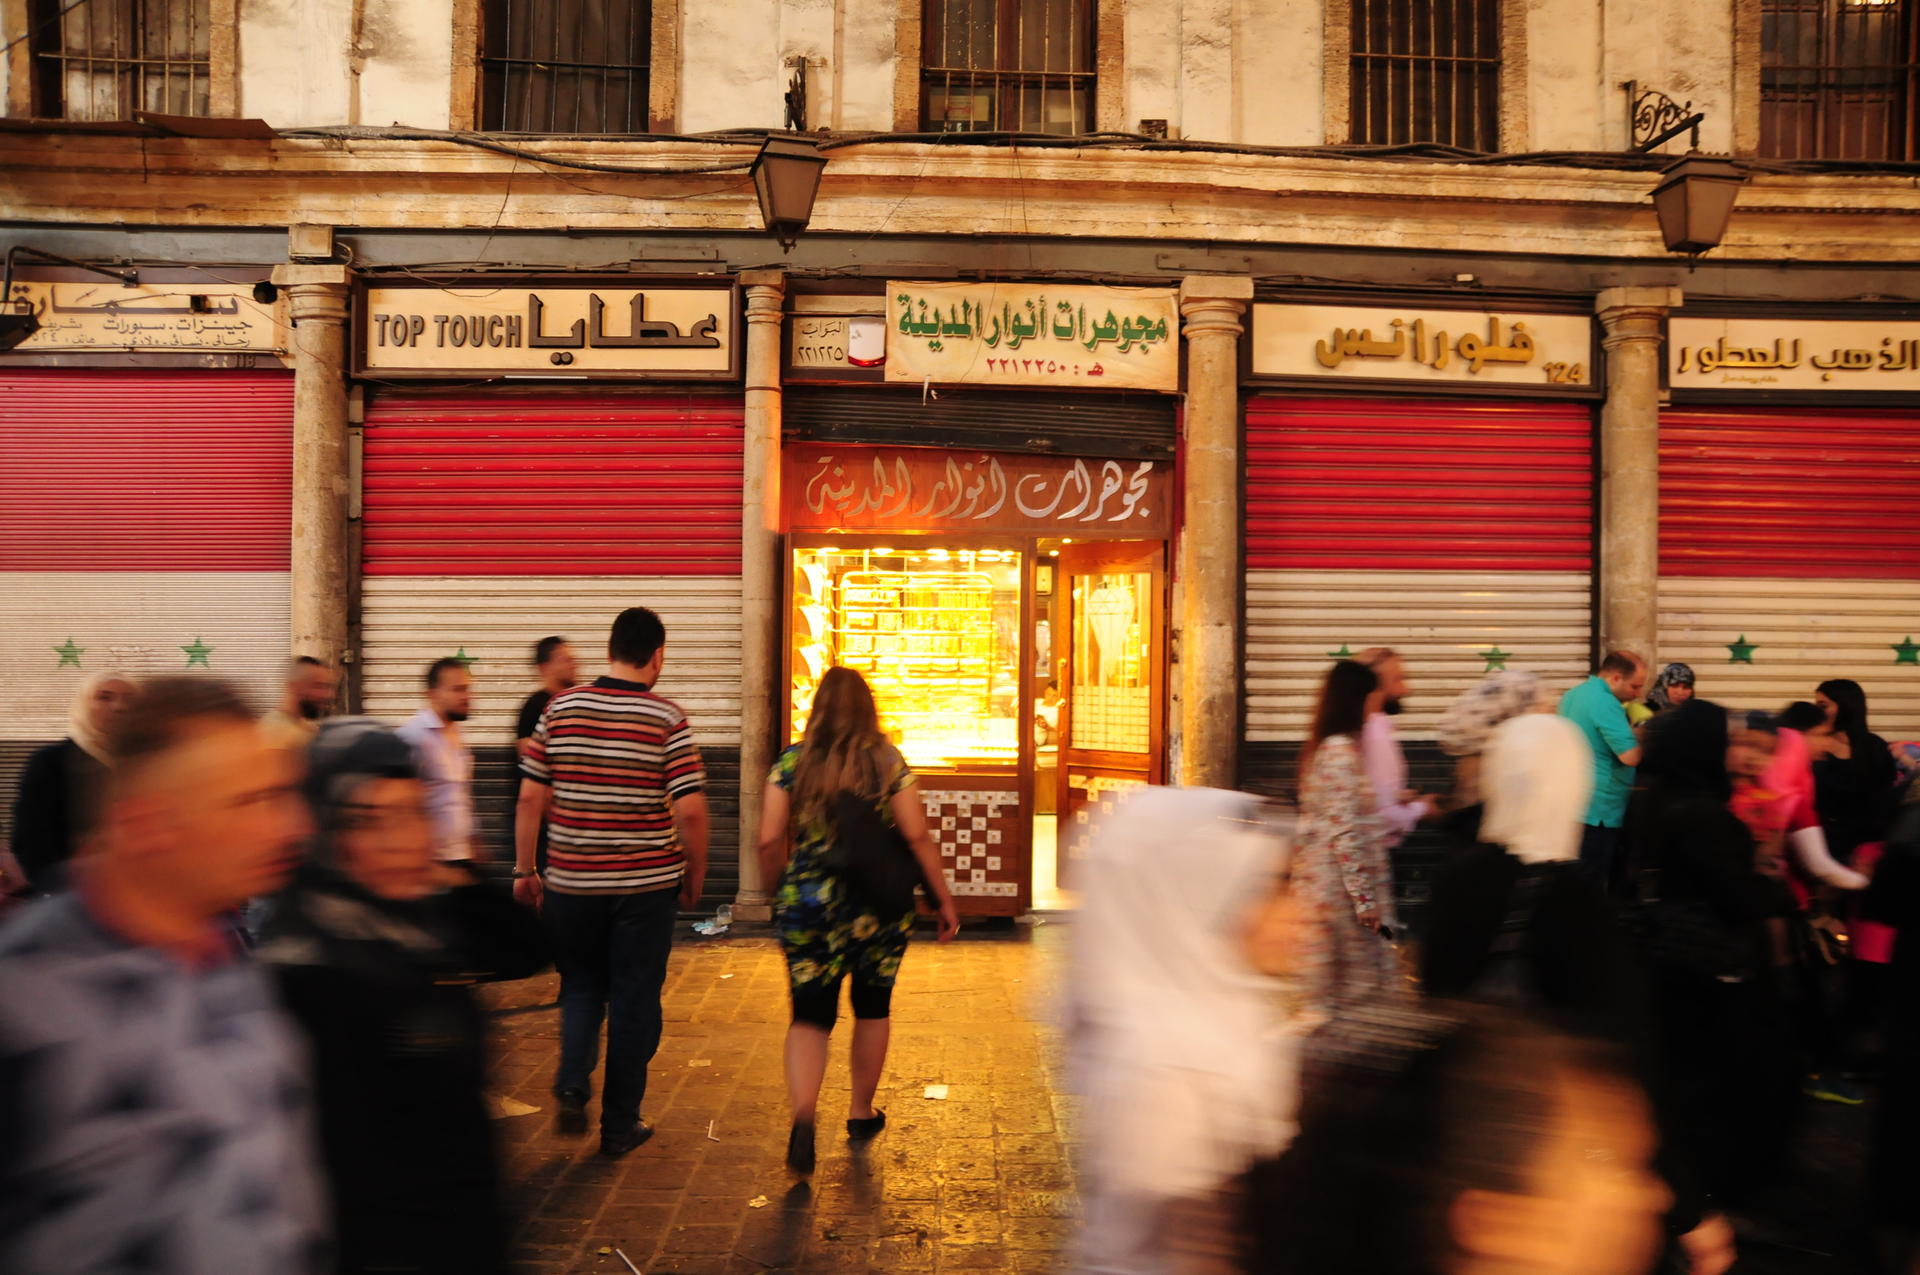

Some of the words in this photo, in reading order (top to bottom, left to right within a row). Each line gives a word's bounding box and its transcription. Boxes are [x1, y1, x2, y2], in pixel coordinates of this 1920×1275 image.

[176, 318, 253, 335] جينزات
[375, 314, 425, 347] TOP
[434, 314, 522, 348] TOUCH
[528, 292, 721, 366] عطايا
[897, 293, 981, 351] المدينة
[984, 294, 1047, 347] أنوار
[1052, 298, 1167, 355] مجوهرات
[1315, 315, 1535, 374] فلورانس
[986, 357, 1066, 375] ٢٢١٢٢٥٠
[1543, 361, 1583, 383] 124
[1677, 335, 1802, 374] للعطور
[1810, 335, 1920, 382] الذهب
[805, 455, 911, 519] المدينة
[1014, 457, 1154, 522] مجوهرات
